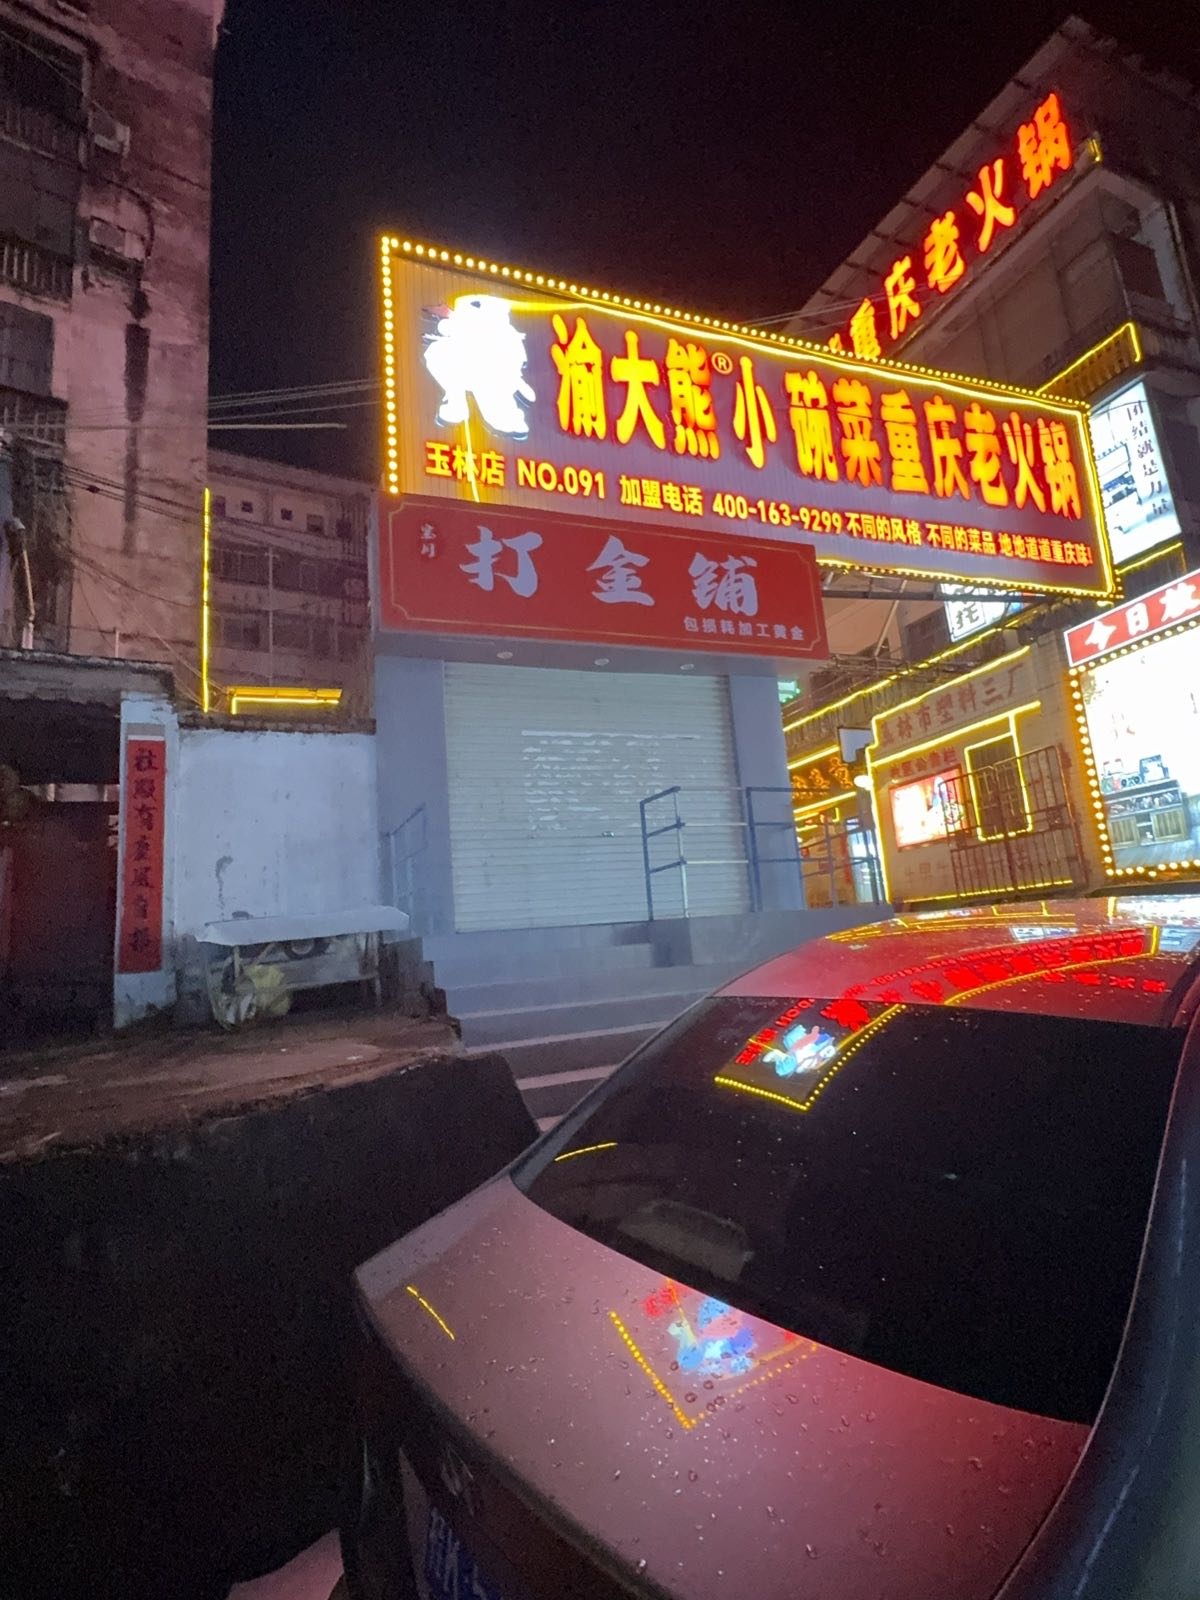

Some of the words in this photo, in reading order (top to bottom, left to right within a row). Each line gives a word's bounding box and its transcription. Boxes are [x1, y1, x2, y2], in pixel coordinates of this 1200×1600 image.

[828, 93, 1071, 359] 重庆老火锅
[425, 441, 505, 486] 玉林店
[517, 459, 606, 499] NO.091
[619, 475, 704, 516] 加盟电话
[712, 491, 842, 535] 400-163-9299
[459, 525, 758, 616] 打金铺
